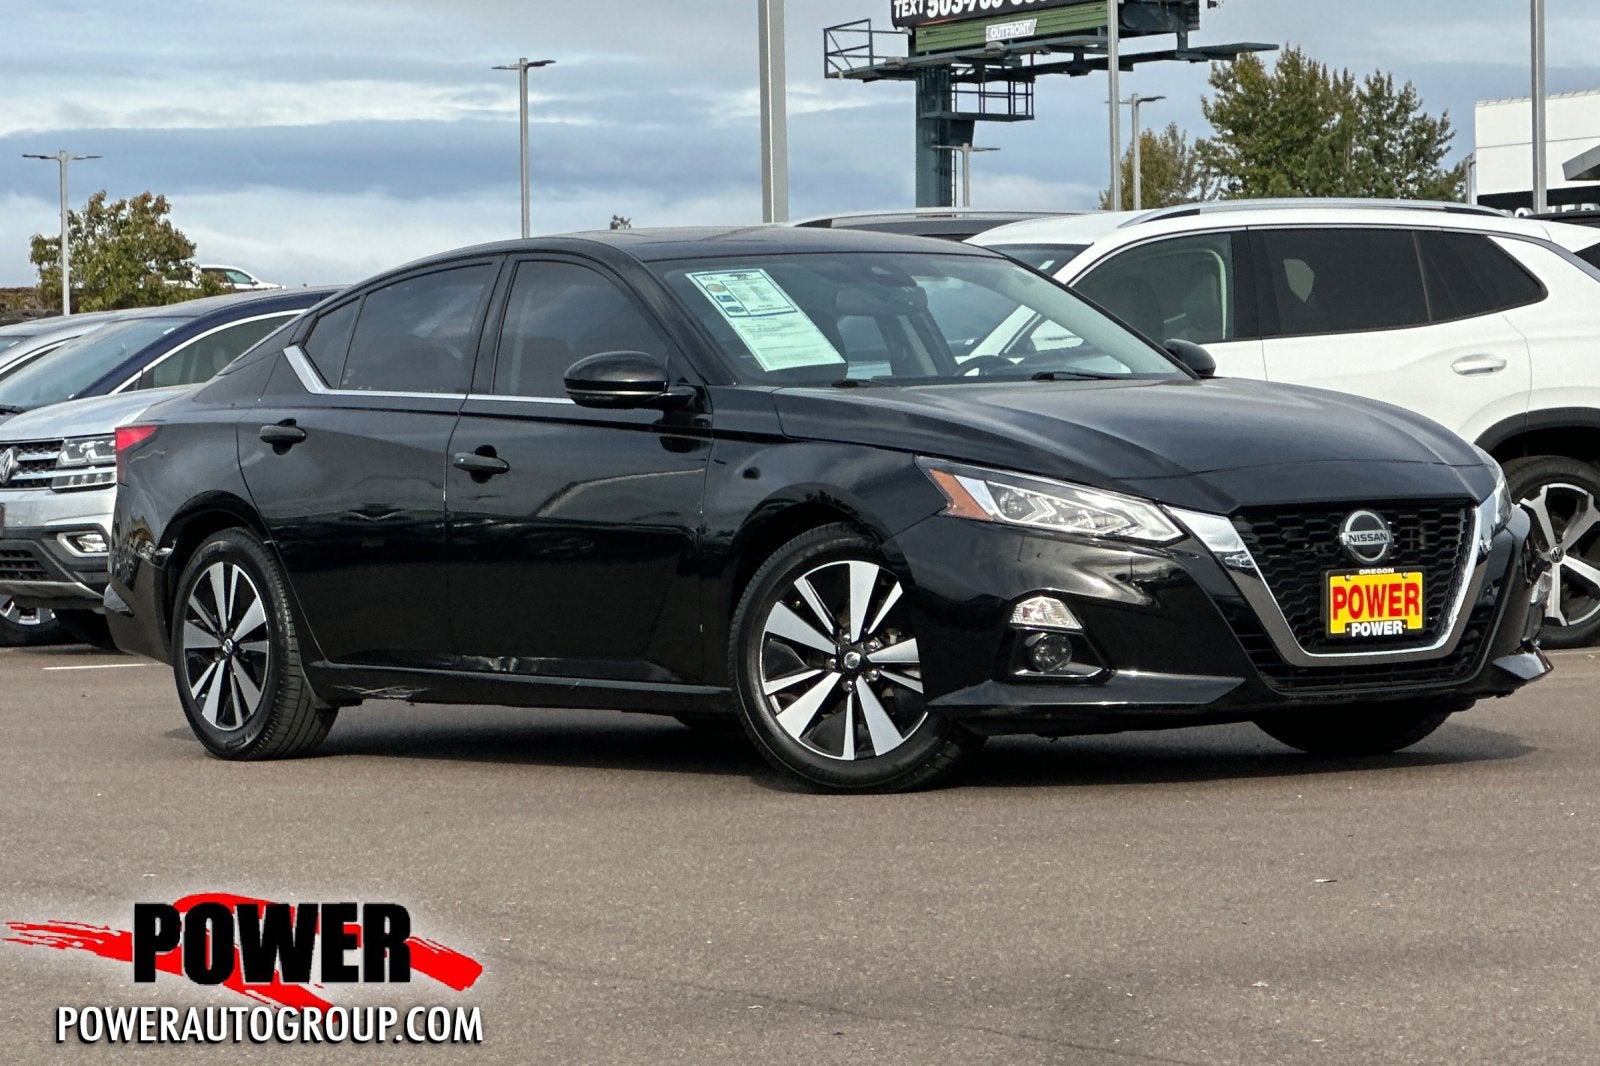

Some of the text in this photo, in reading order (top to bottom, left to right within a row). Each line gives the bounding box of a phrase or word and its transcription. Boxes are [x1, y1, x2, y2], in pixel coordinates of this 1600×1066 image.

[990, 23, 1032, 38] OUTFRONT
[1349, 532, 1388, 543] NISSAN
[1358, 567, 1395, 575] OREGON
[1332, 582, 1420, 620] POWER
[1351, 620, 1404, 637] POWER
